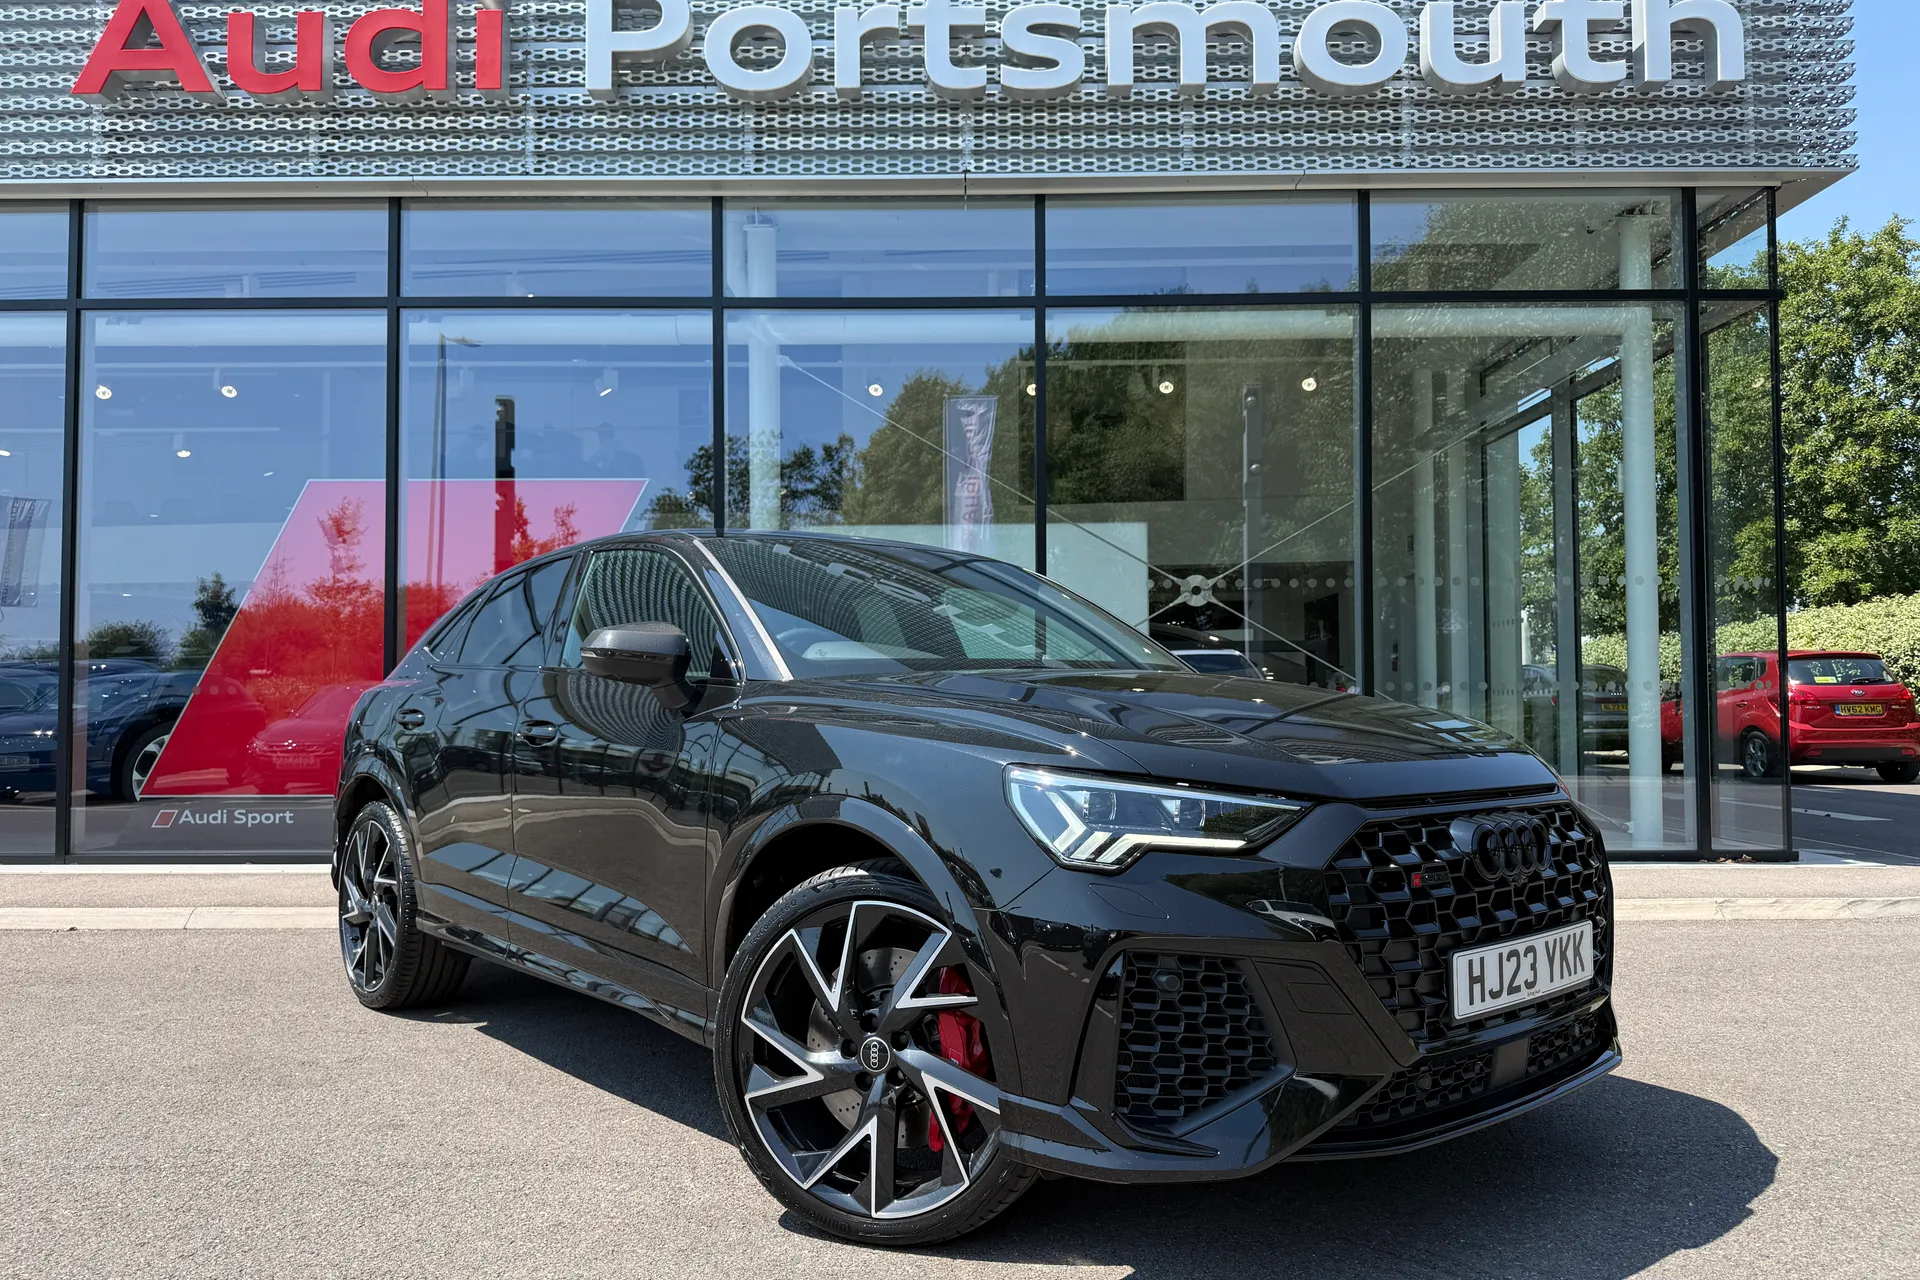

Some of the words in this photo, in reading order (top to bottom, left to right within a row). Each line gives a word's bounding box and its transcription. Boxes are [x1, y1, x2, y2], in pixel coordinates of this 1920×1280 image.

[71, 0, 507, 96] Audi
[585, 0, 1746, 95] Portsmouth
[1840, 705, 1863, 714] HV62
[1864, 705, 1881, 714] KMG
[178, 810, 227, 824] Audi
[233, 810, 294, 827] Sport
[1468, 944, 1538, 1006] HJ23
[1544, 929, 1585, 984] YKK
